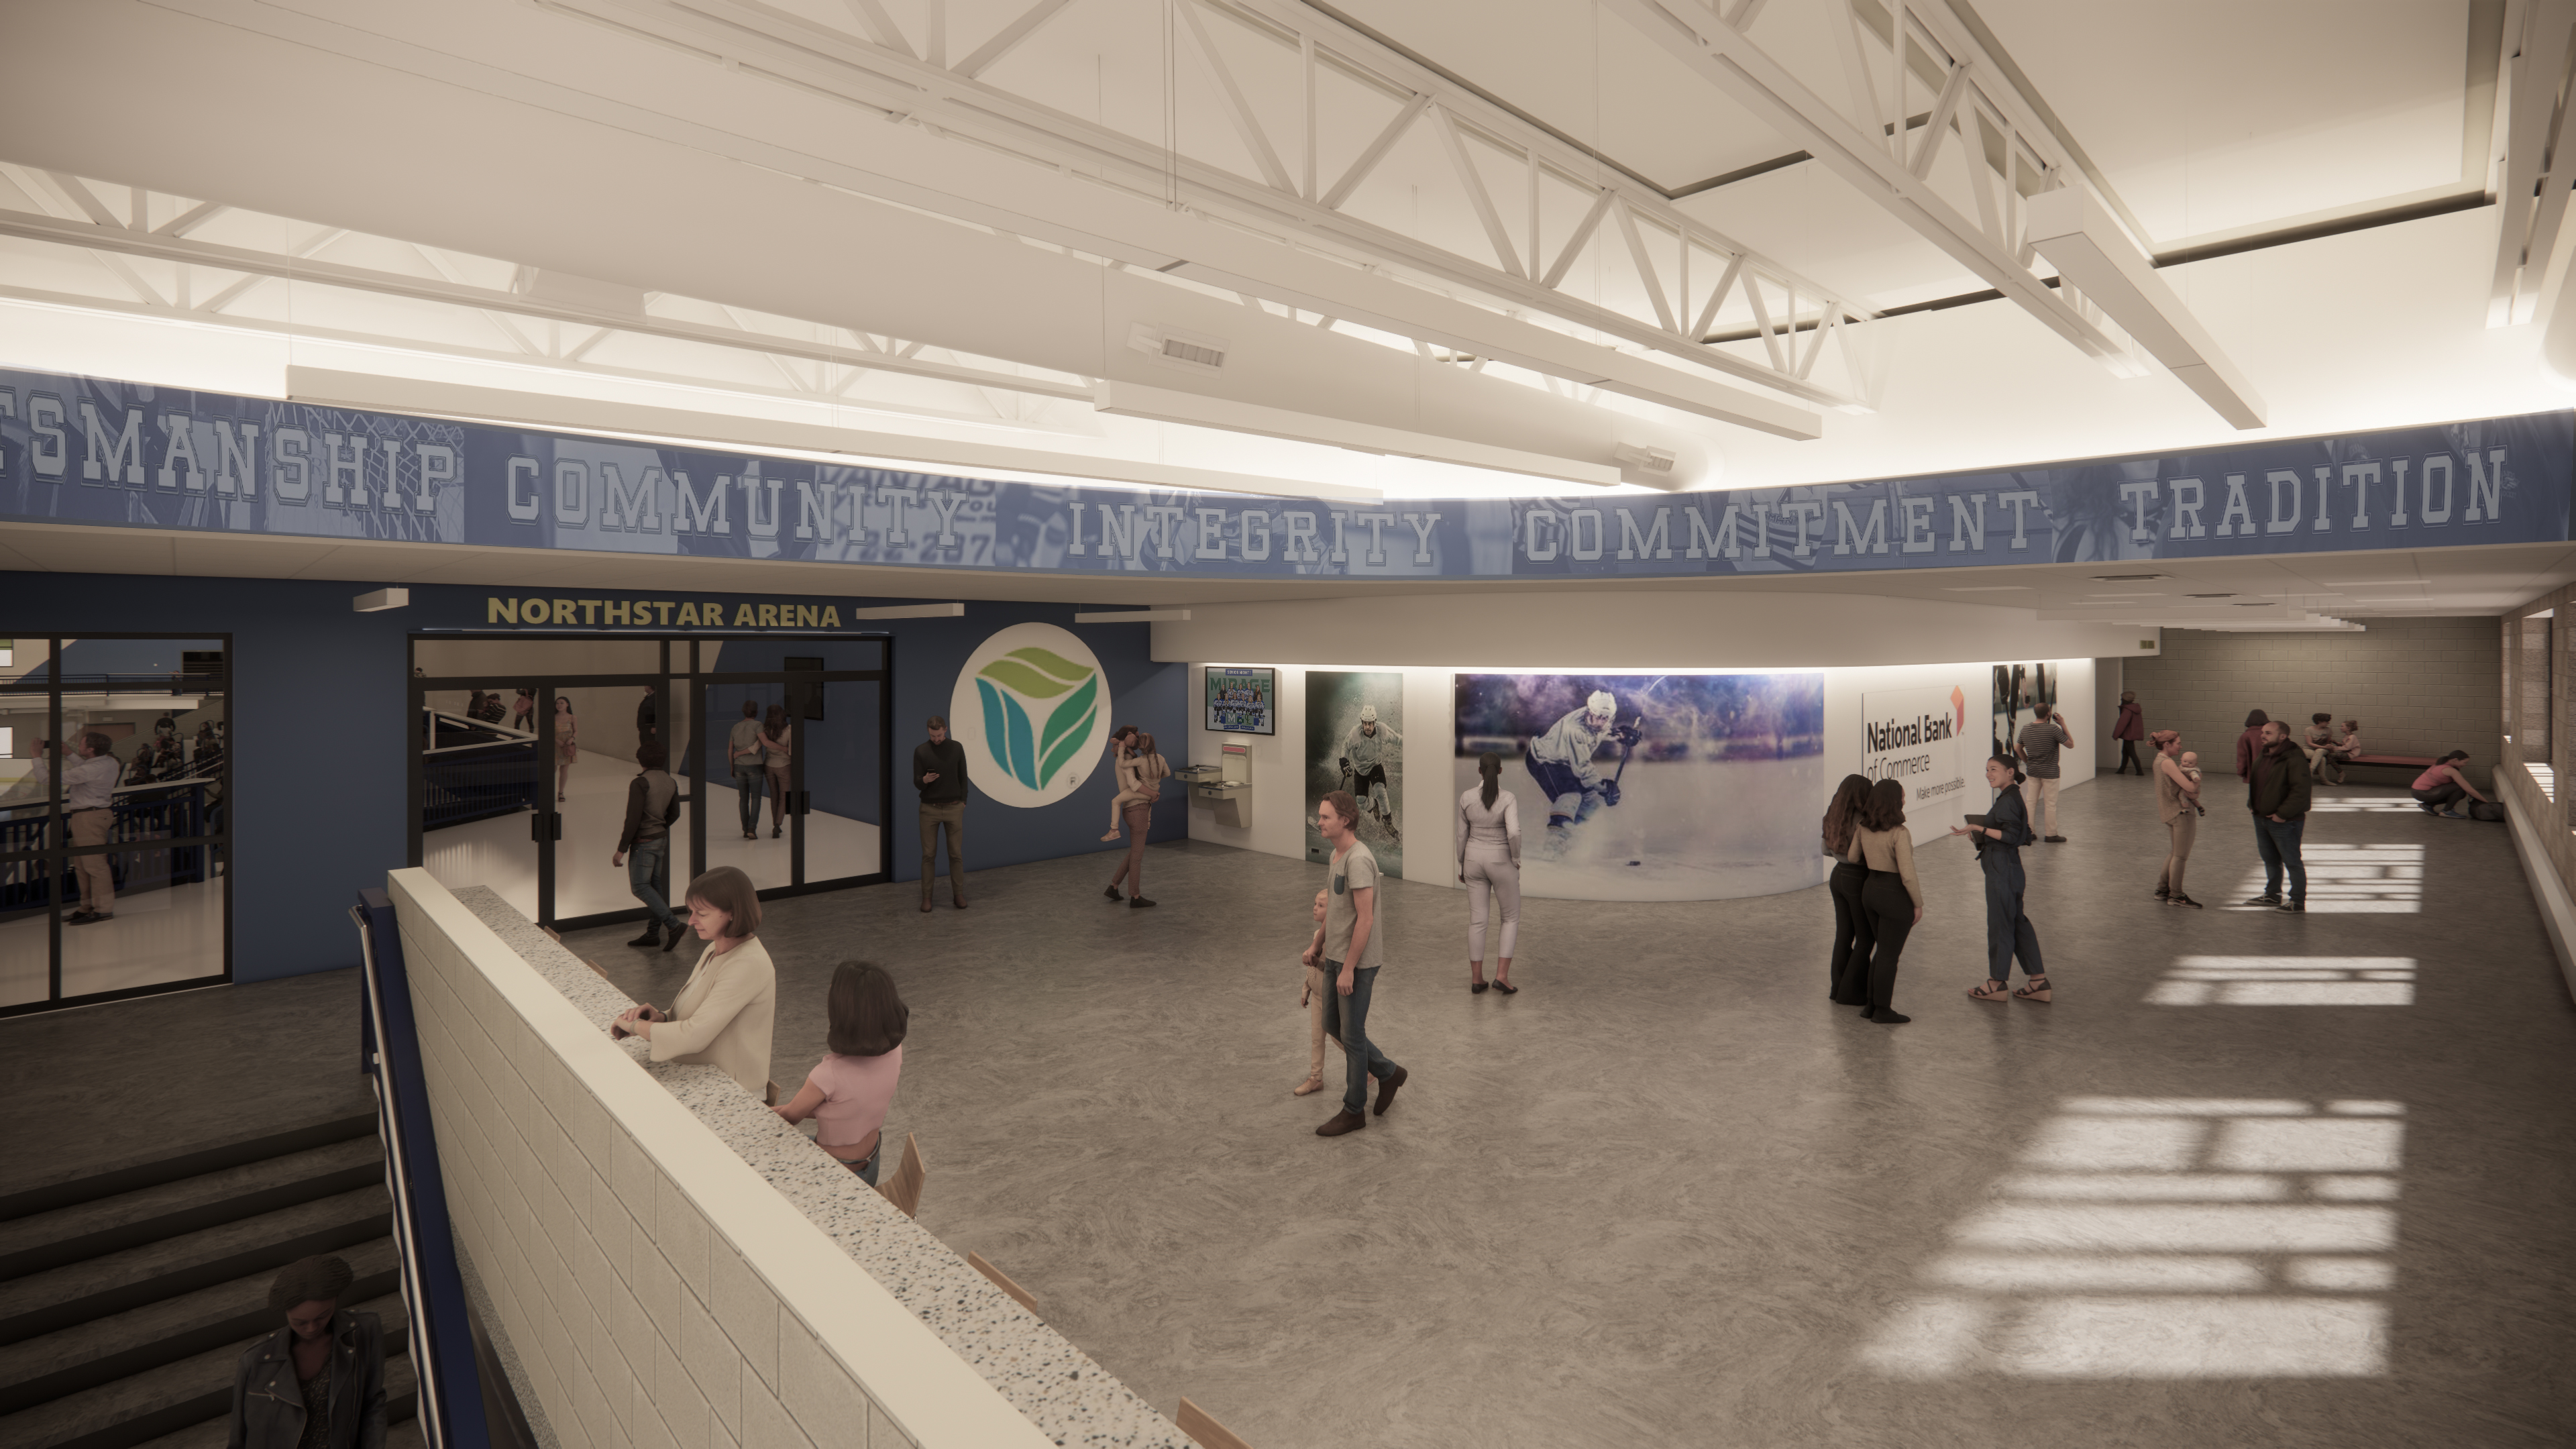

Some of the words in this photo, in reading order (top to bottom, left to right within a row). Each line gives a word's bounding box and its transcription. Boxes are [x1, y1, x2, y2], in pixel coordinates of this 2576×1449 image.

[505, 452, 969, 550] COMMUNITY
[1067, 500, 1444, 566] INTEGRITY
[1523, 487, 2042, 565] COMMITMENT
[2117, 445, 2507, 544] TRADITION
[487, 597, 724, 627] NORTHSTAR
[733, 603, 842, 628] ARENA
[1211, 678, 1271, 693] MIRAGE
[1868, 716, 1921, 753] National
[1924, 712, 1952, 743] Bank
[1867, 759, 1877, 784] of
[1880, 755, 1929, 780] Commerce
[1916, 786, 1930, 802] Make
[1931, 785, 1943, 797] more
[1945, 777, 1965, 796] possible.
